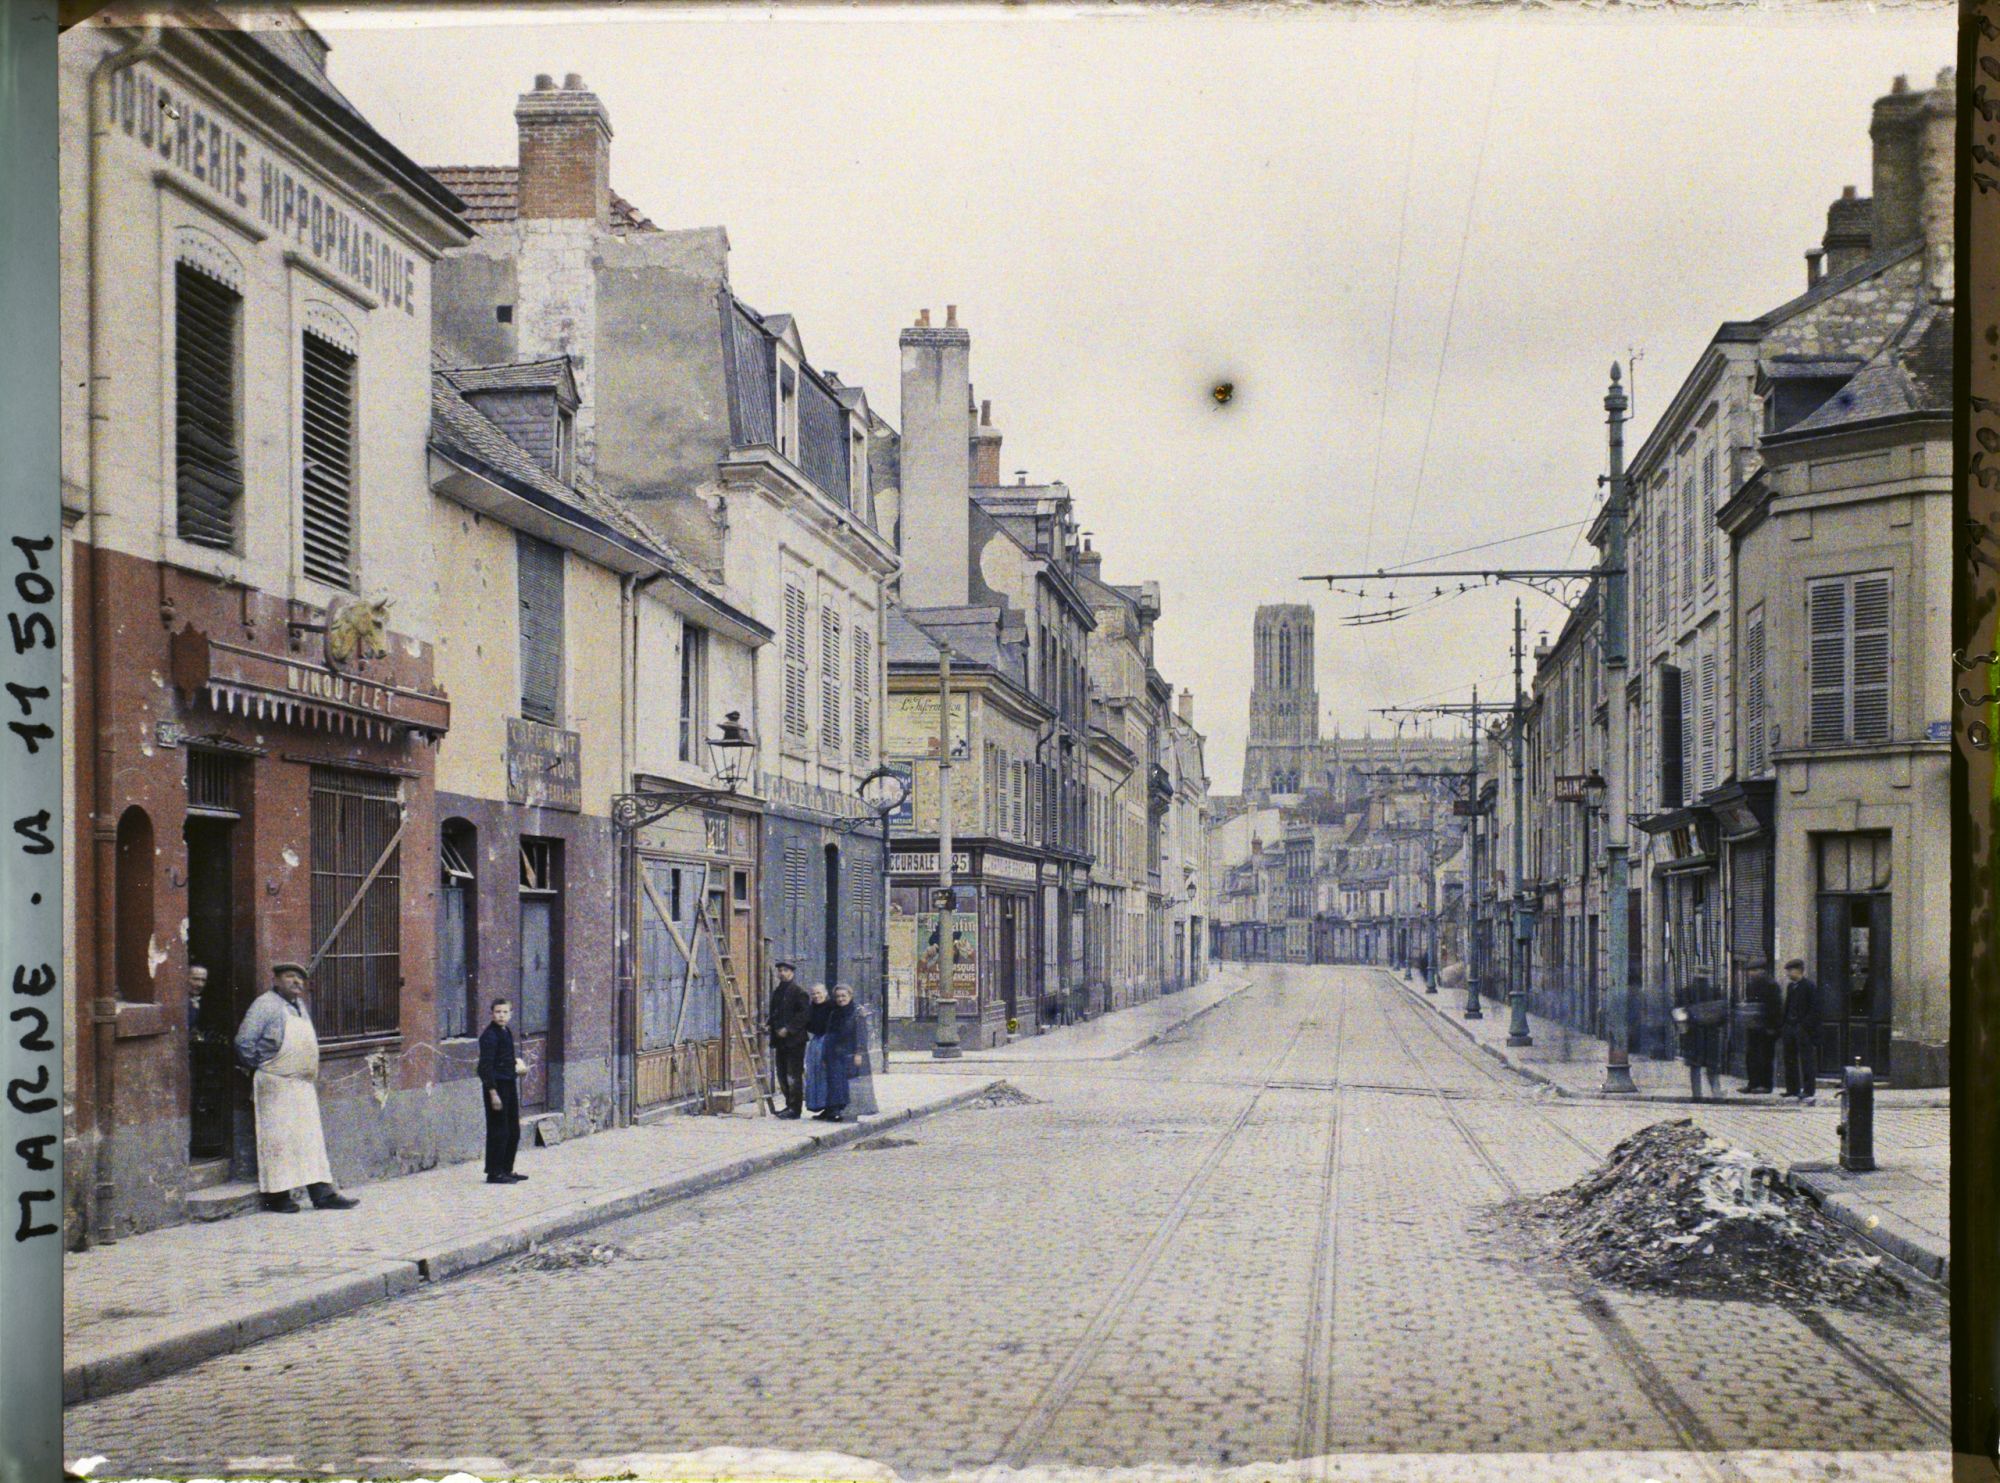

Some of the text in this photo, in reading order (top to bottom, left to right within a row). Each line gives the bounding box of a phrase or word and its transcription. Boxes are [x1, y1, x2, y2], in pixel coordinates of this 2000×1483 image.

[260, 156, 415, 318] HIPPOPHAGIQUE
[13, 808, 55, 856] A
[889, 854, 934, 871] CCURSALE
[7, 964, 58, 1242] MARNE
